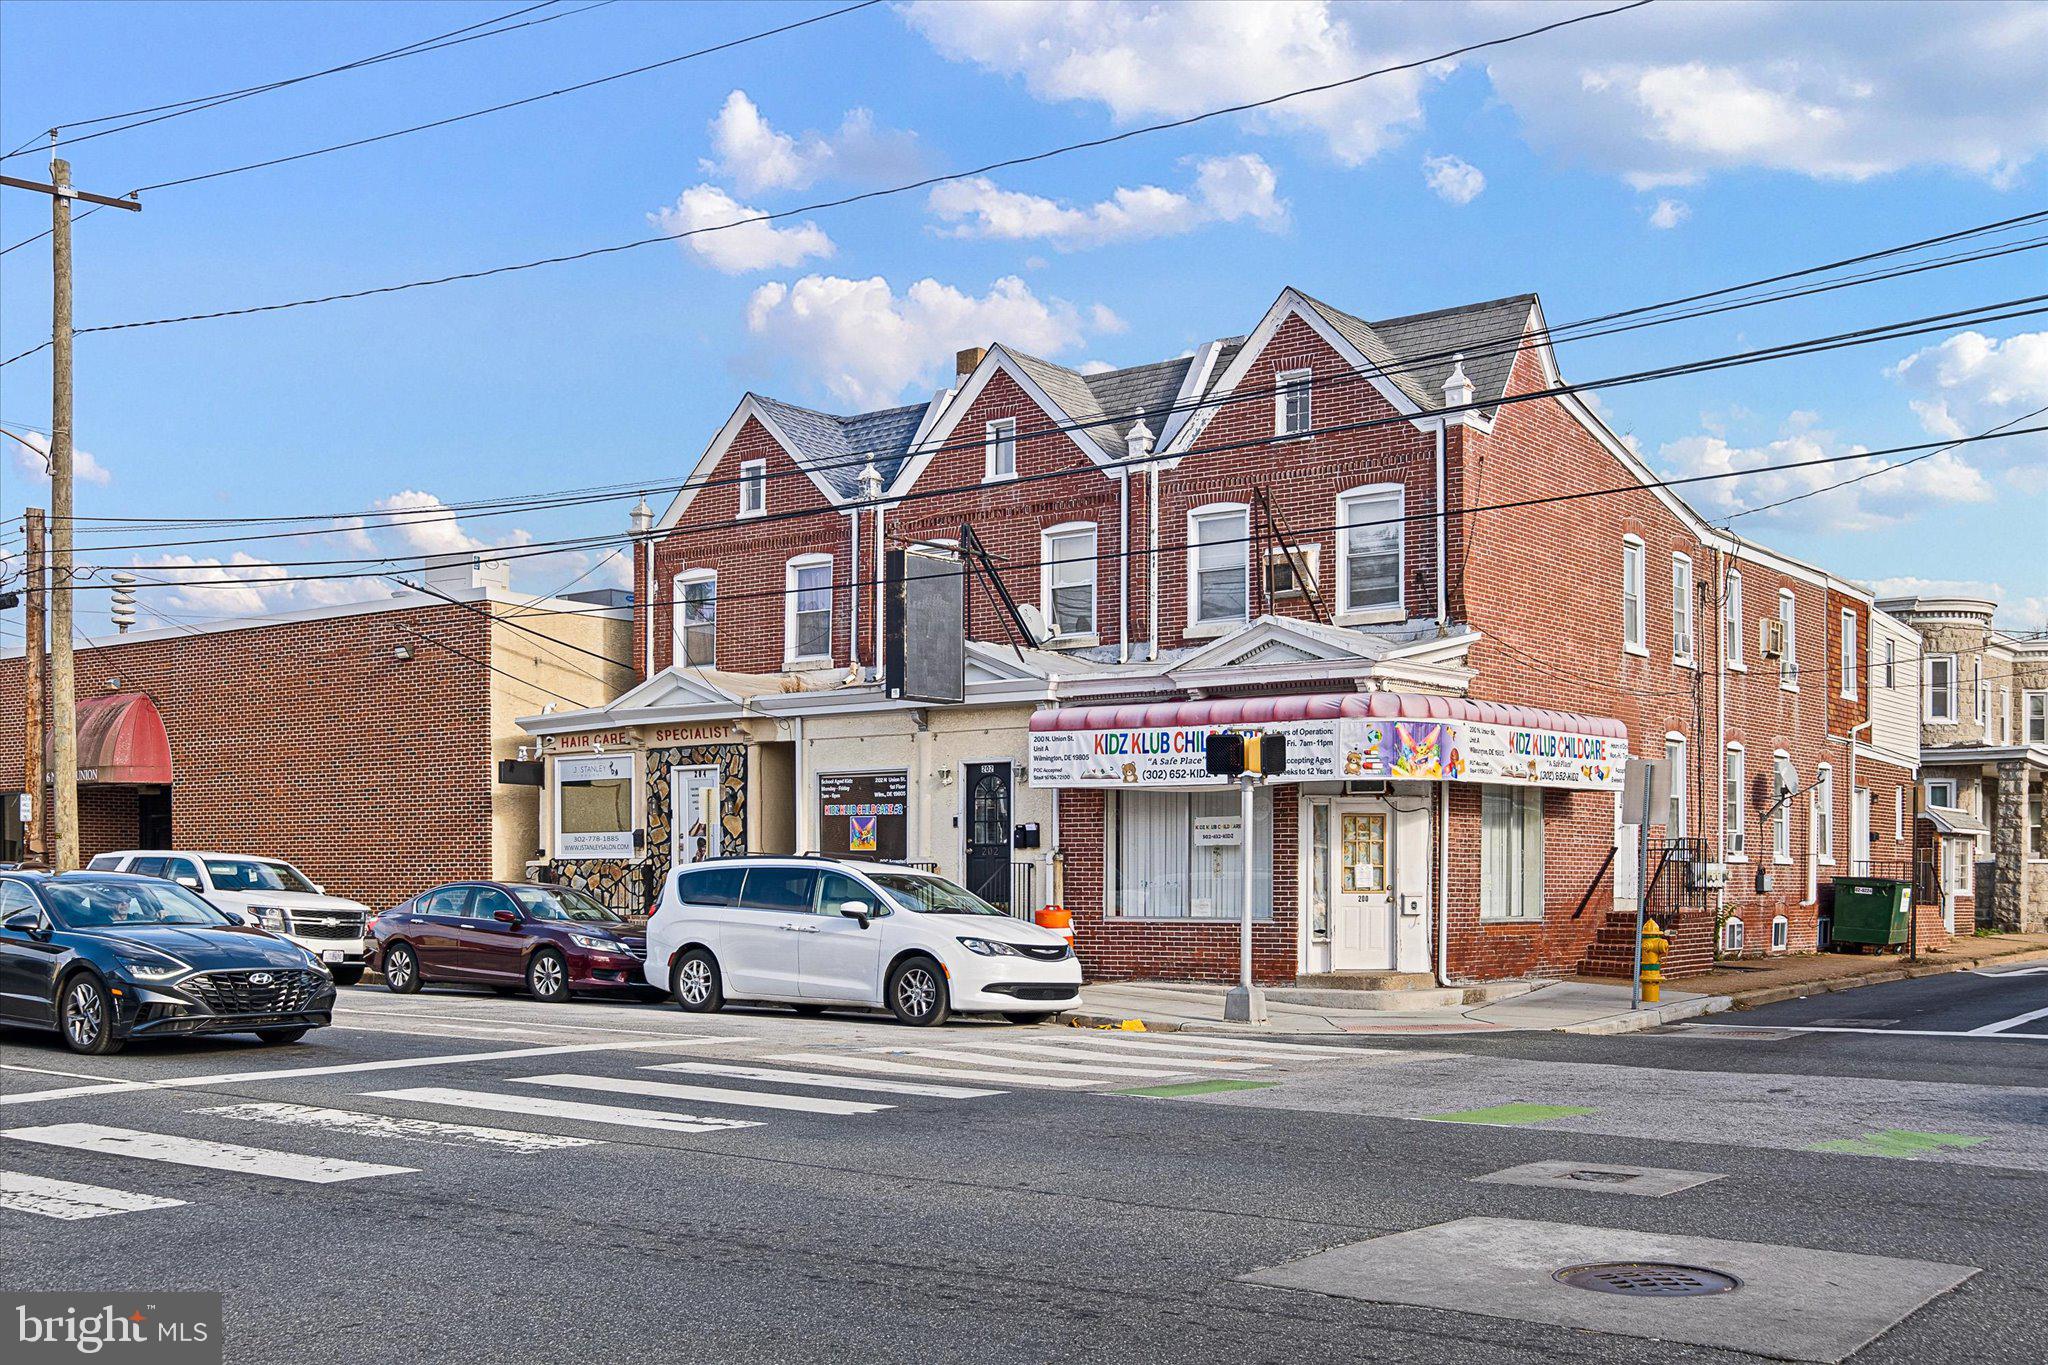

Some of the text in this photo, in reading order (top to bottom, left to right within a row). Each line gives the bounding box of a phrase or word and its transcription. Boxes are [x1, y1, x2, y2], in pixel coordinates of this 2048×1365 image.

[656, 726, 730, 742] SPECIALIST
[1300, 728, 1333, 736] Operation:
[561, 732, 626, 748] HAIR CARE
[1094, 733, 1128, 755] KIDZ
[1131, 732, 1170, 754] KLUB
[1509, 731, 1607, 760] KIDZ KLUB CHILDCARE
[1160, 757, 1177, 765] Safe
[1286, 757, 1332, 765] ccepting Ages
[581, 765, 606, 773] STANLEY
[981, 765, 994, 773] 202
[76, 769, 98, 781] UNION
[1142, 769, 1167, 780] (302)
[824, 804, 840, 815] KIDZ
[840, 804, 856, 815] KLUB
[857, 803, 894, 815] CHILDCARE
[574, 835, 620, 843] 302-778-1885
[982, 847, 999, 856] 202
[1357, 895, 1369, 903] 200
